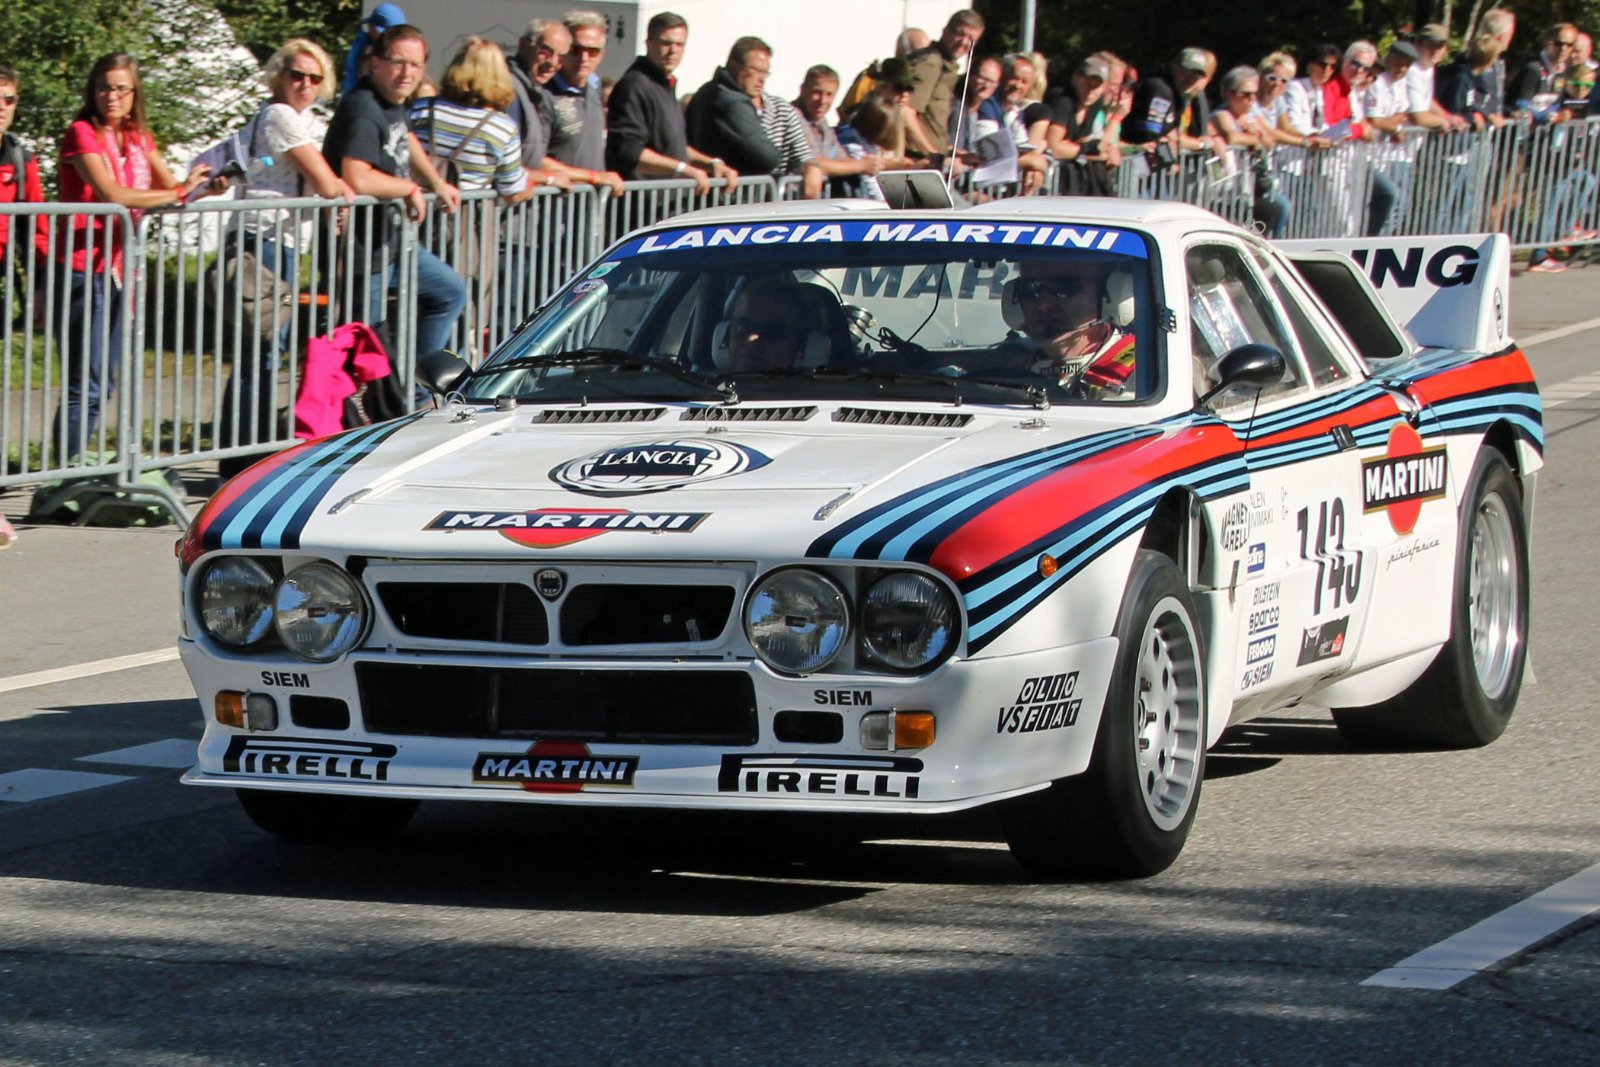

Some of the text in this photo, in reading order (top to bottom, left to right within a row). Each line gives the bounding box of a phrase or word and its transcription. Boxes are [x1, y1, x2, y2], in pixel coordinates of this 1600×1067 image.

[637, 223, 1120, 254] LANCIA MARTINI
[602, 451, 698, 466] LANCIA
[1365, 455, 1445, 502] MARTINI
[445, 513, 692, 529] MARTINI
[1253, 581, 1280, 606] BILSTEIN
[1249, 606, 1279, 634] sparco
[261, 671, 310, 688] SIEM
[1252, 661, 1274, 686] SIEM
[814, 689, 872, 706] SIEM
[1018, 673, 1078, 703] OLIO
[223, 735, 397, 781] PIRELLI
[481, 758, 628, 780] MARTINI
[718, 753, 924, 799] PIRELLI
